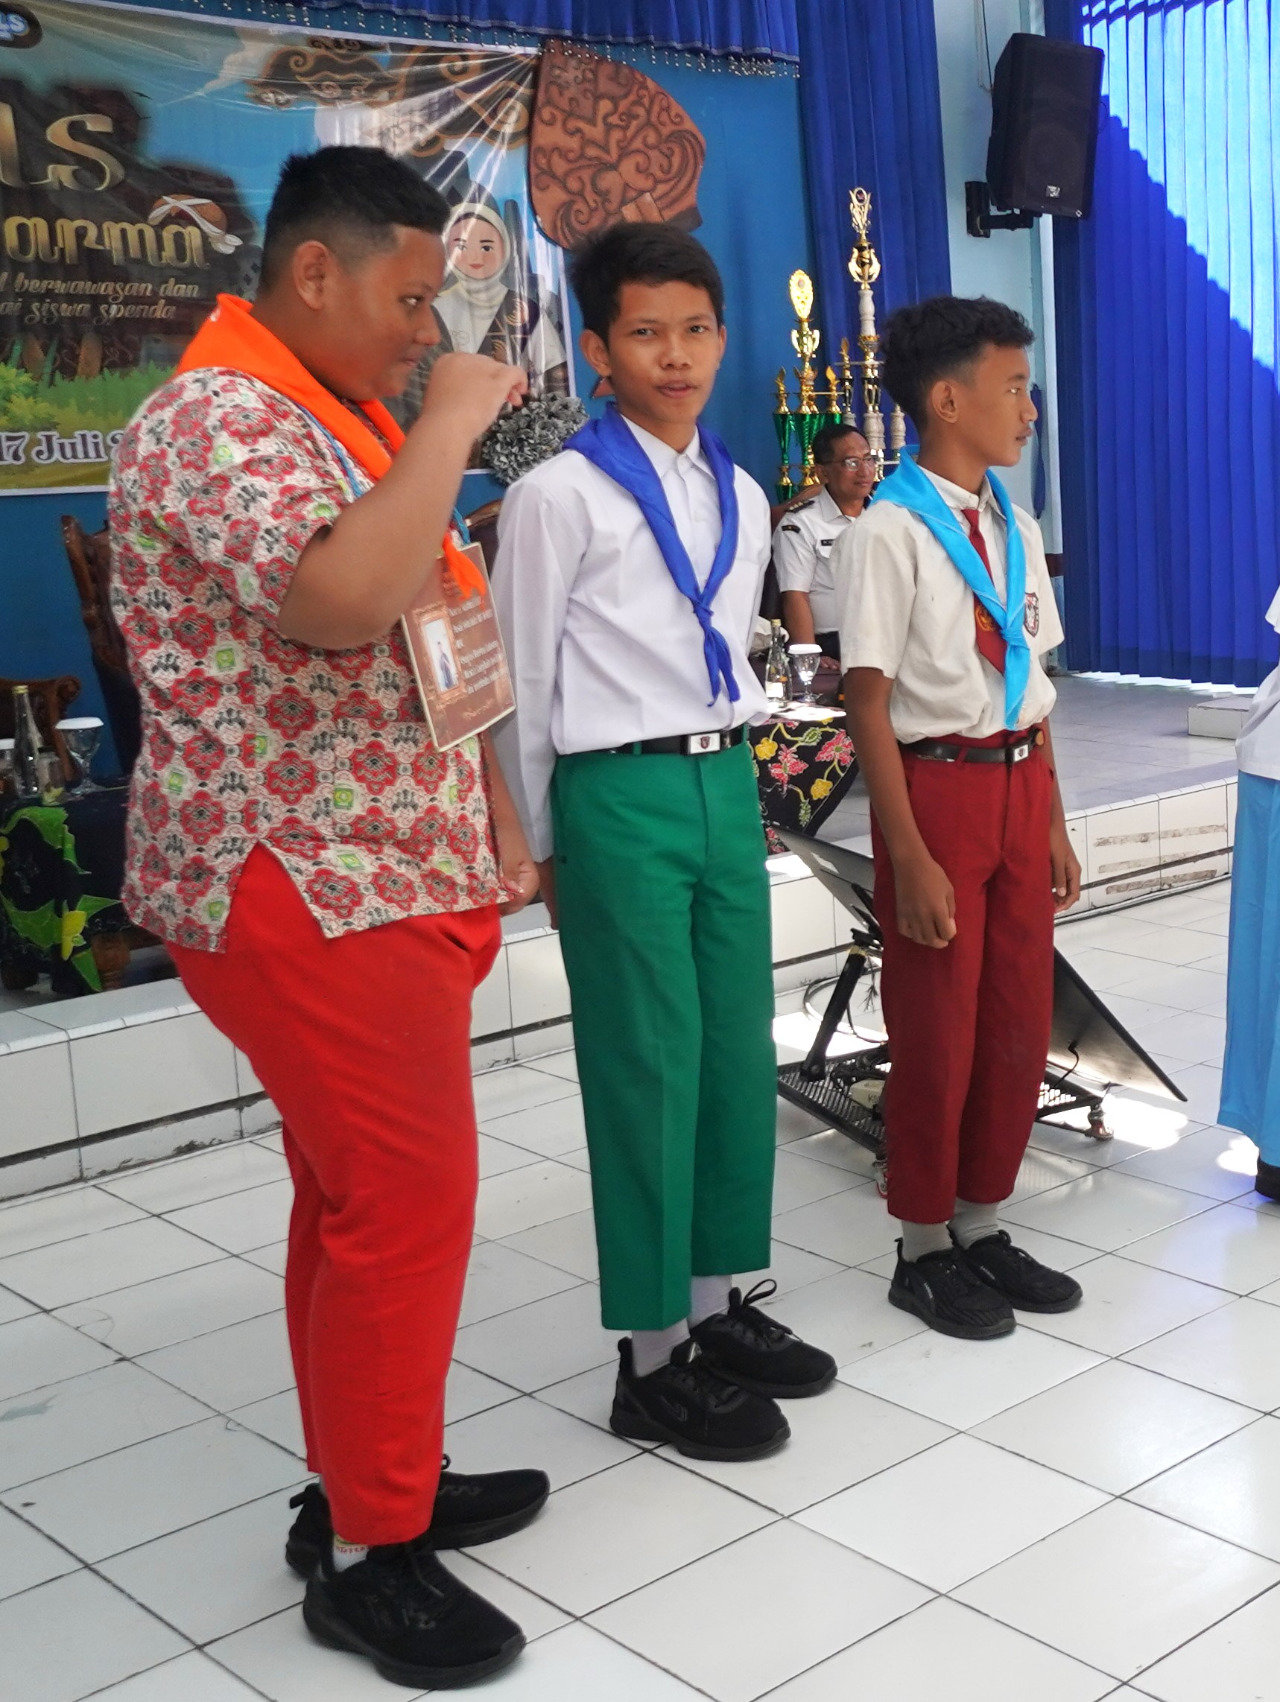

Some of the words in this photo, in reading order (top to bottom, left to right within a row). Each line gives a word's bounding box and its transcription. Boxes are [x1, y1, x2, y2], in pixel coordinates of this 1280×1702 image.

[14, 272, 153, 303] berwawasan
[160, 277, 200, 297] dan
[24, 298, 91, 325] siswa
[94, 299, 176, 326] spenda
[33, 431, 108, 464] Juli
